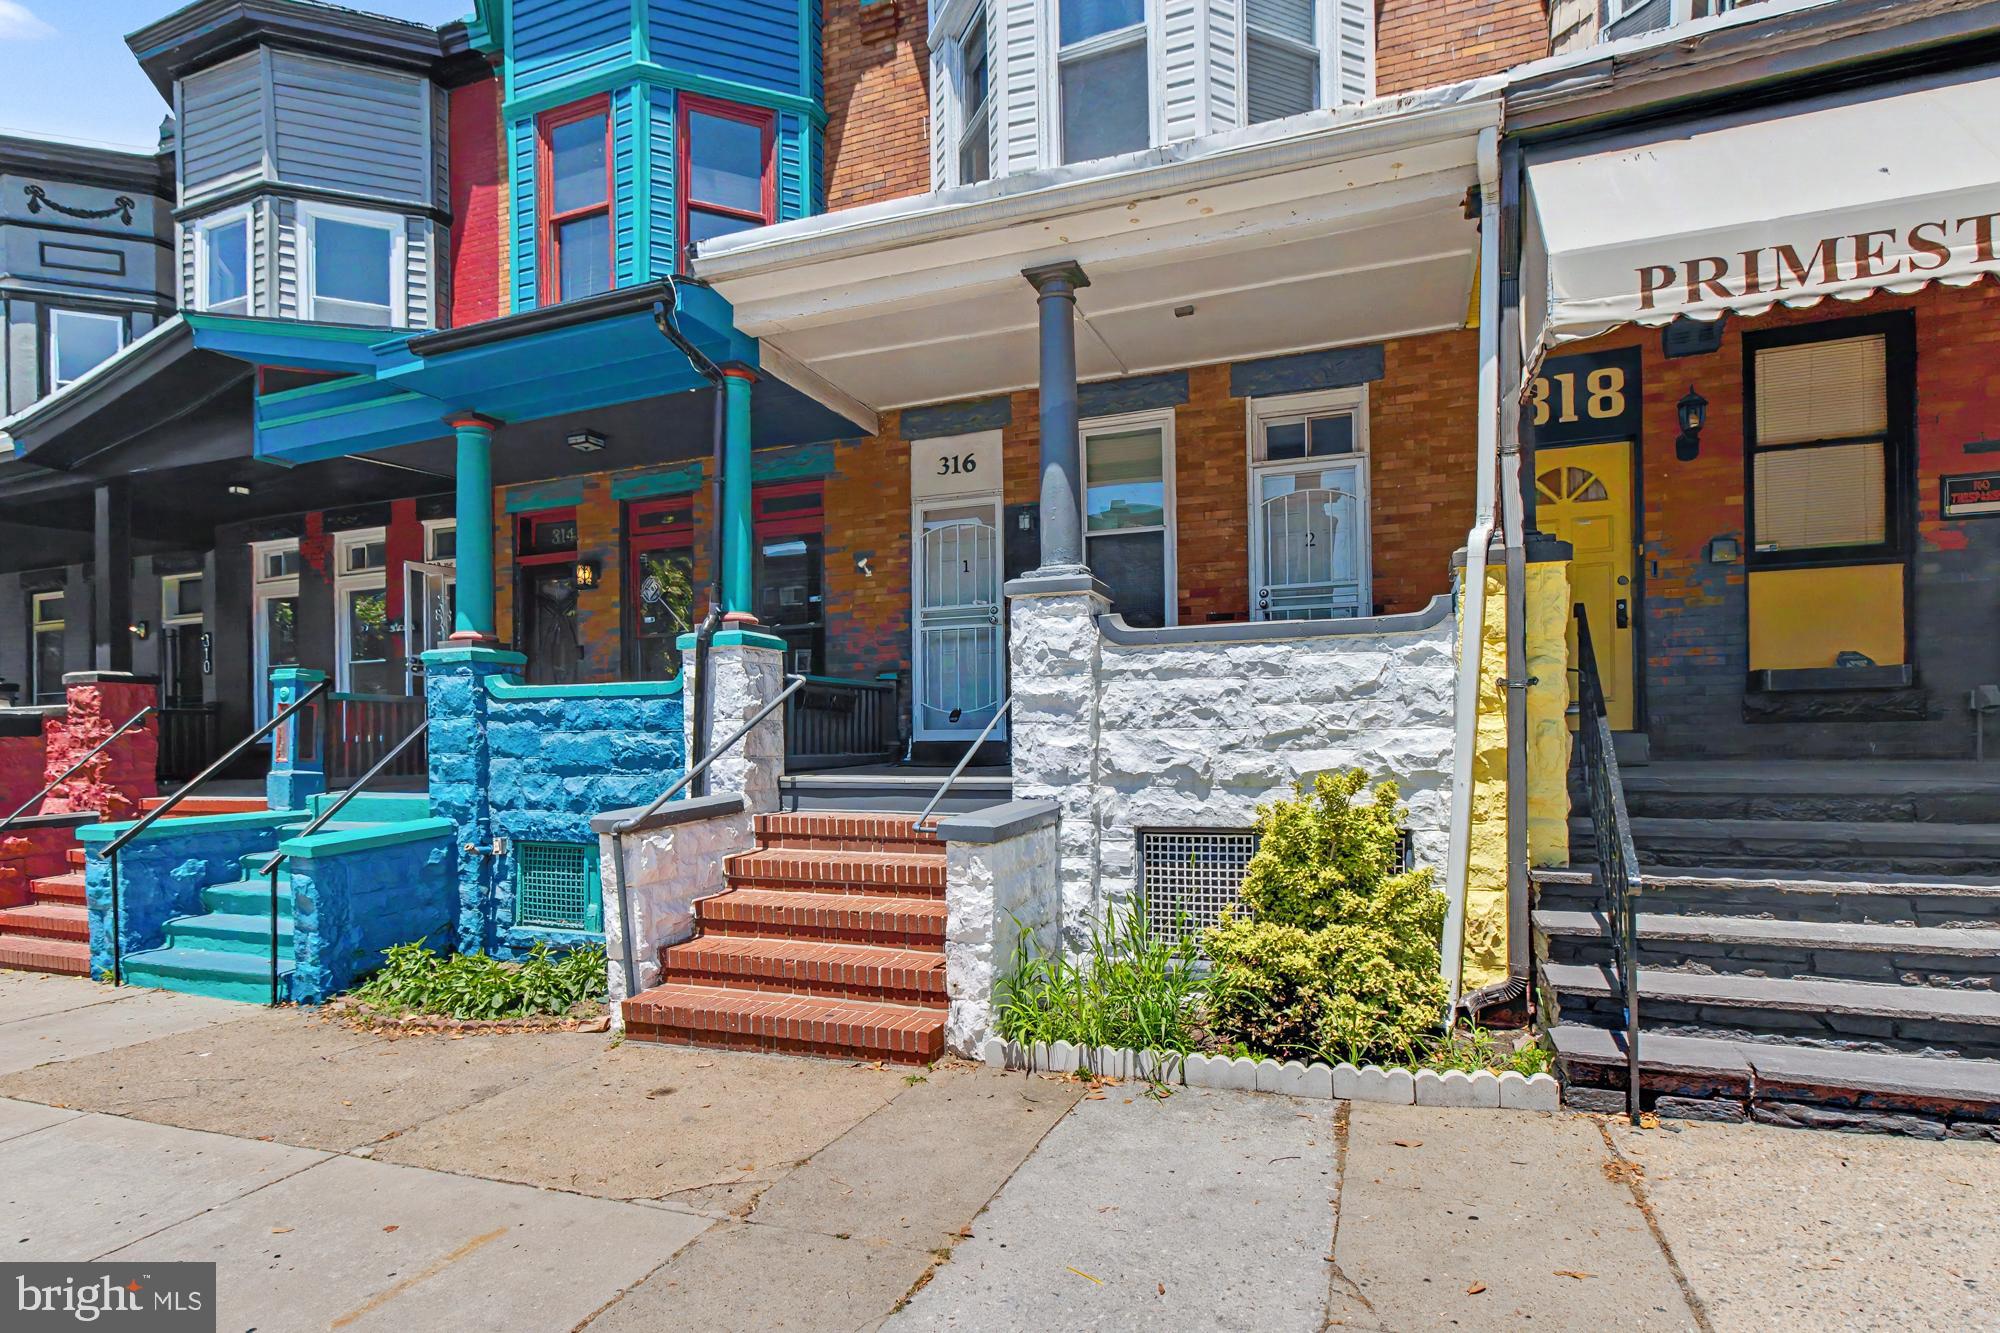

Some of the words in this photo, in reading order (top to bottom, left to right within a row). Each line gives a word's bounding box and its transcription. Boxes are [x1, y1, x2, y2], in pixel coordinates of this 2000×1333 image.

[937, 453, 977, 475] 316
[551, 527, 577, 545] 314
[1305, 532, 1316, 547] 2
[962, 560, 970, 573] 1
